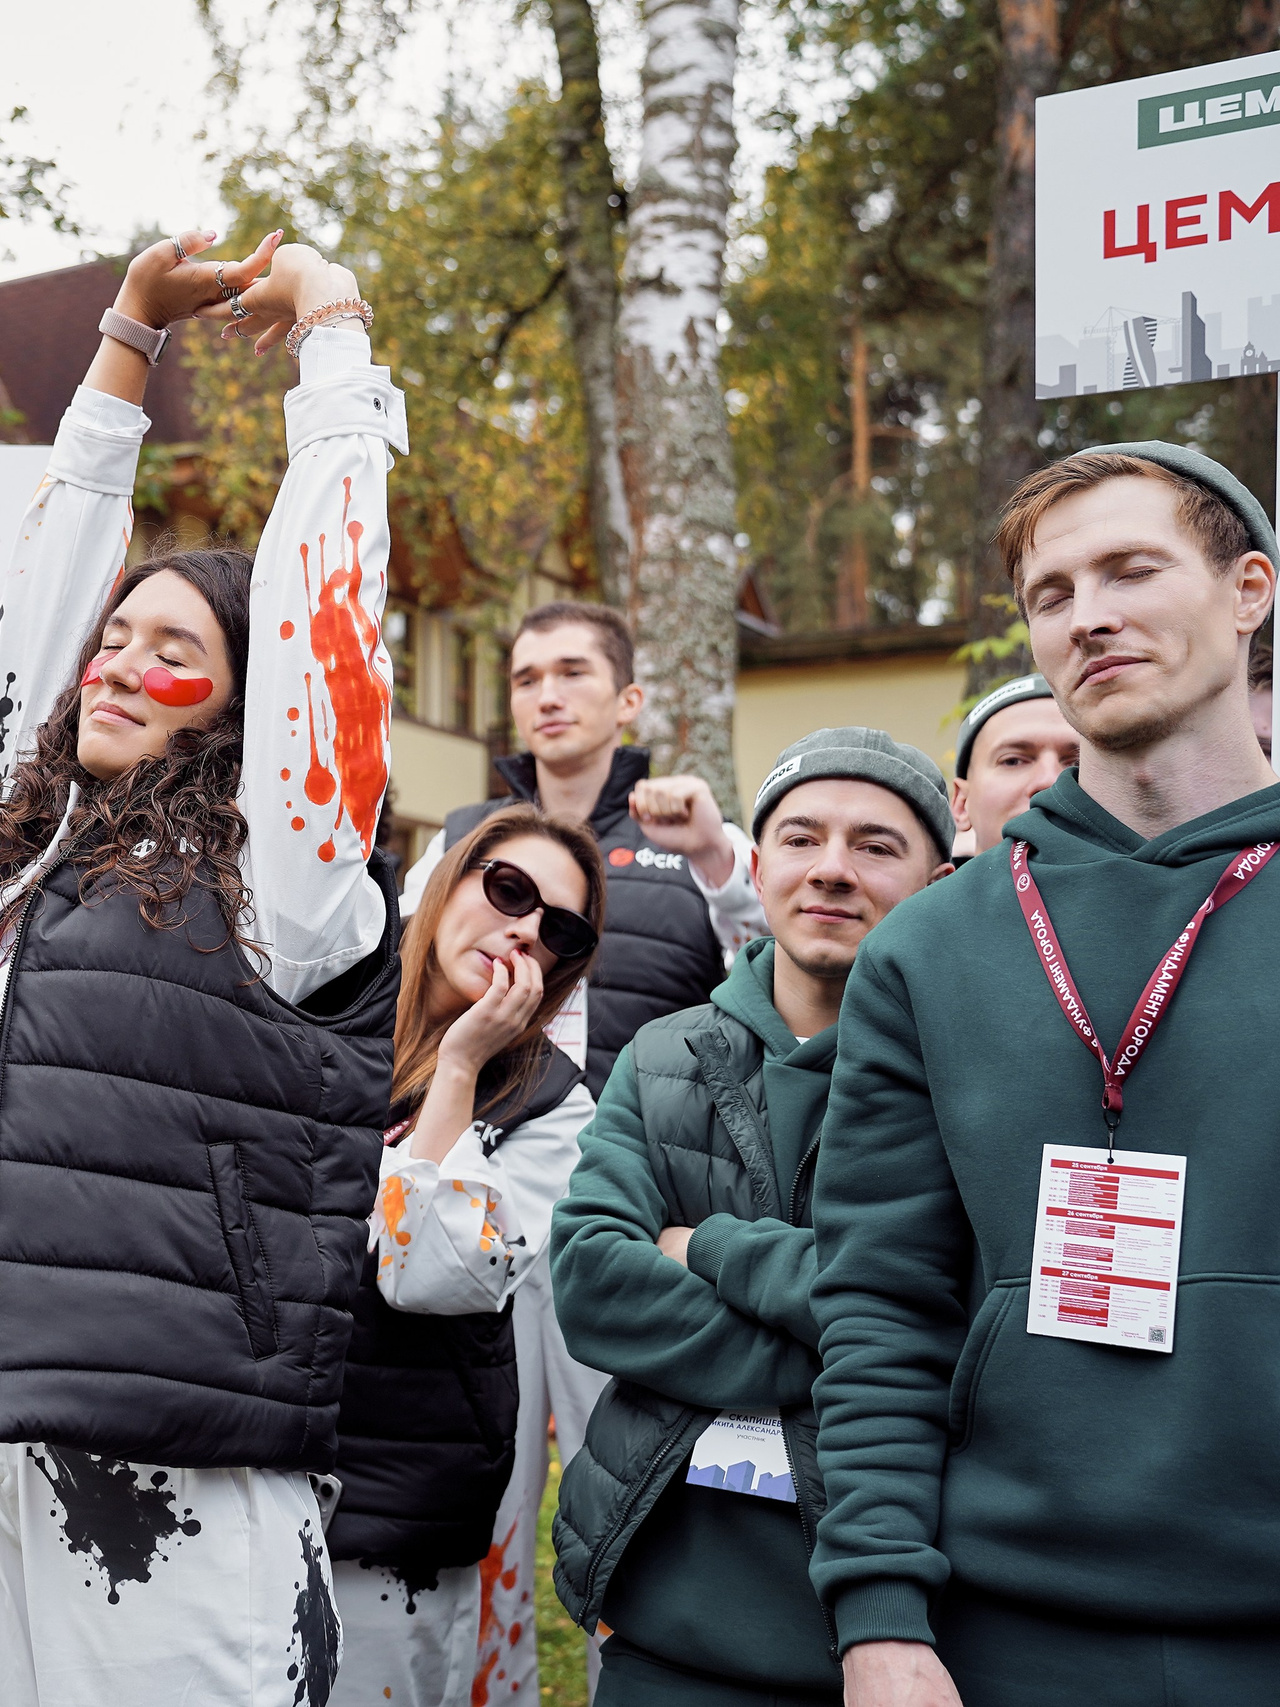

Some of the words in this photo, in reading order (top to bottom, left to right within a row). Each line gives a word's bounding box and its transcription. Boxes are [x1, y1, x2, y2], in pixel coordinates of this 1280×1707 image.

[1158, 85, 1280, 134] ЦЕМ
[1103, 181, 1280, 264] ЦЕМ
[635, 847, 684, 871] ФСК
[1232, 841, 1275, 880] ОРОДА
[1030, 909, 1057, 962] ГОРОДА
[1049, 961, 1092, 1037] ФУНДАМЕНТ
[1143, 932, 1190, 1018] ФУНДАМЕНТ
[1114, 1017, 1153, 1076] ГОРОДА
[472, 1120, 504, 1147] СК
[710, 1420, 734, 1429] ИКИТА
[736, 1423, 784, 1436] АЛЕКСАНДР
